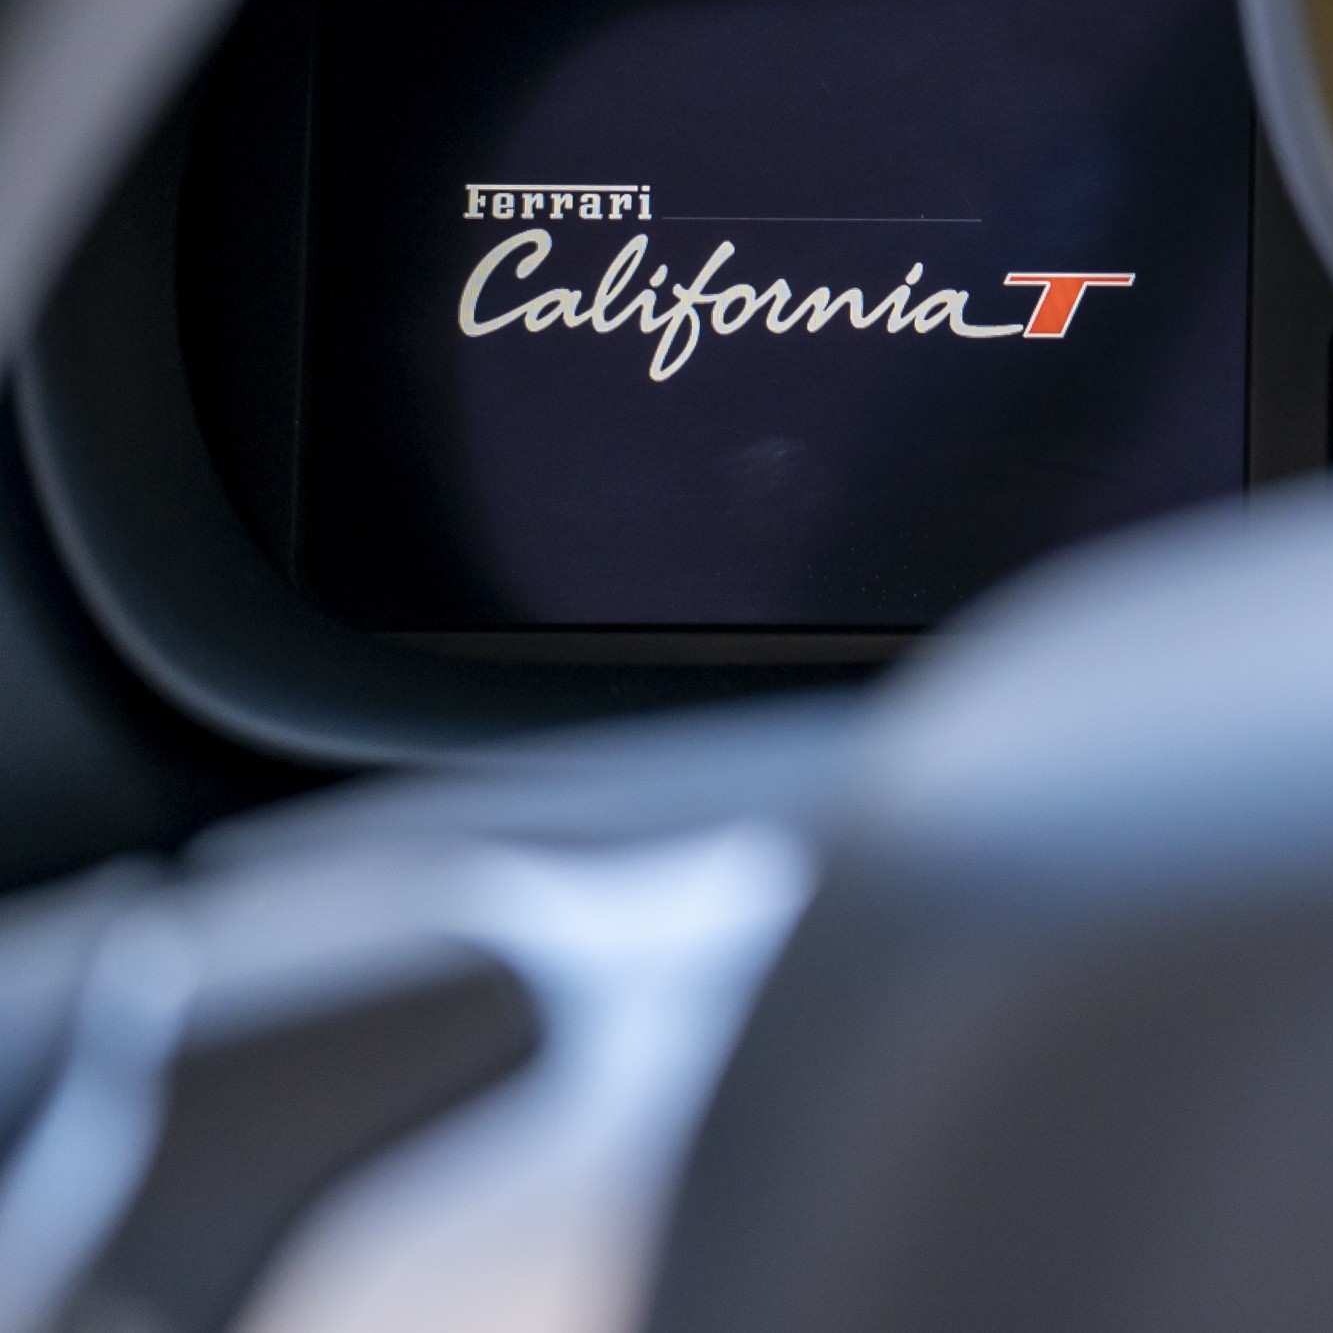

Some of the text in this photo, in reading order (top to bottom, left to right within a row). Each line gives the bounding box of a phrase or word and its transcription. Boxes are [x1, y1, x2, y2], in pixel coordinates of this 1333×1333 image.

[463, 184, 652, 220] Ferrari
[459, 229, 1136, 382] California T
